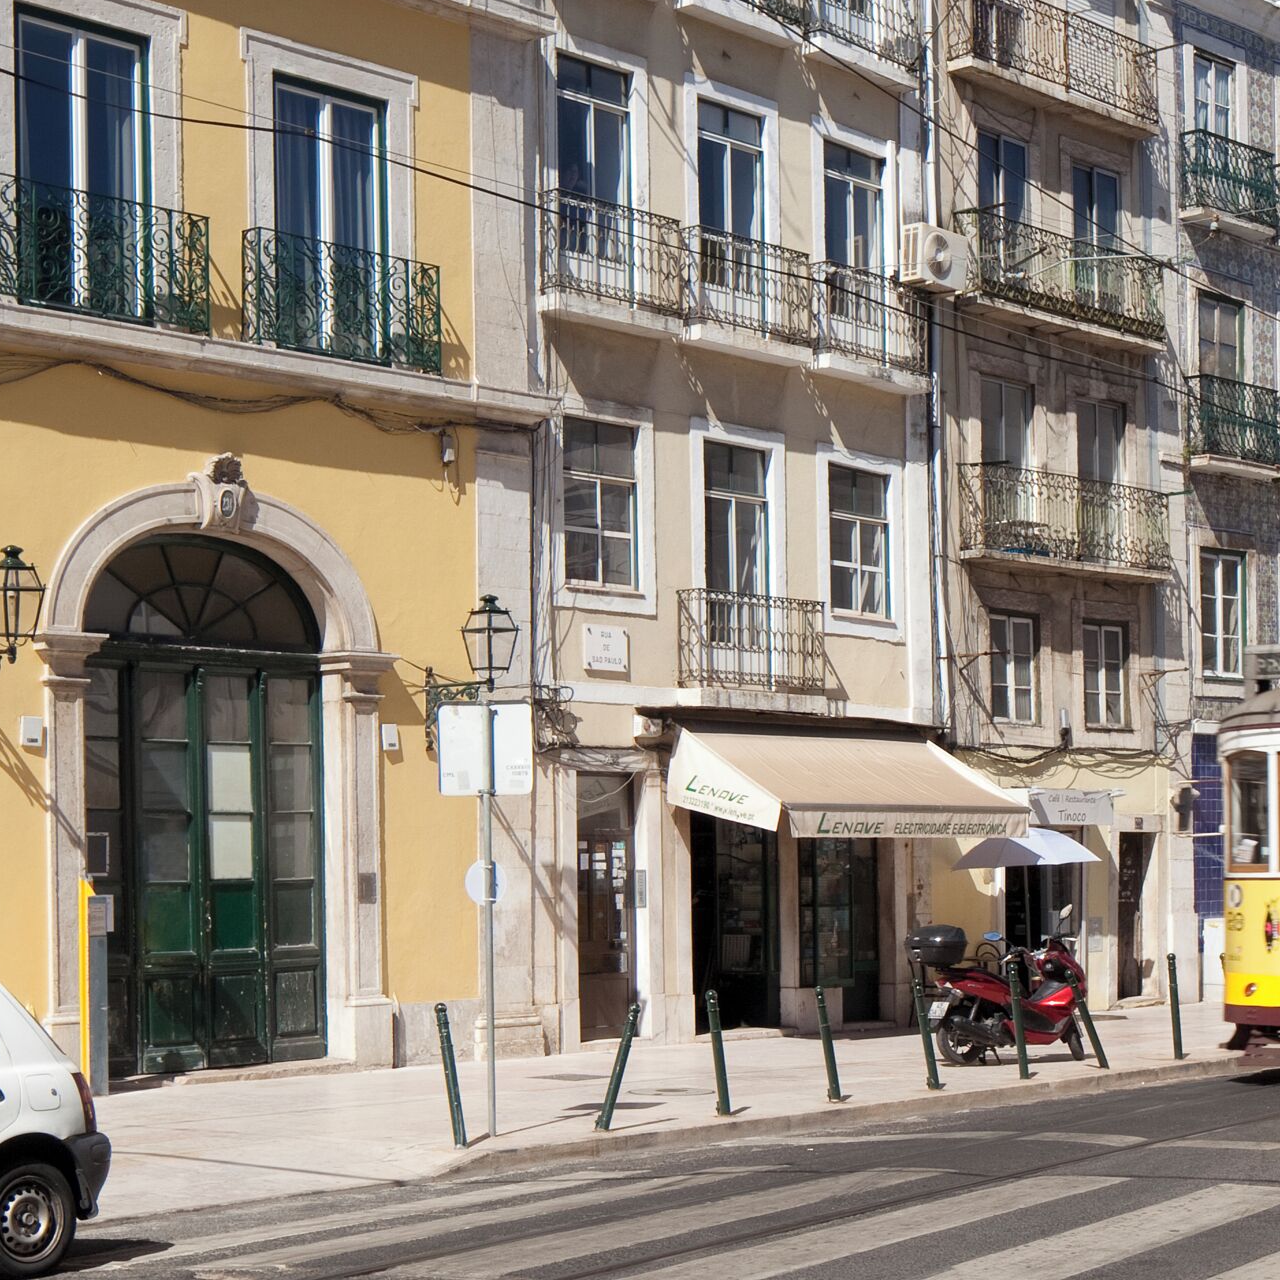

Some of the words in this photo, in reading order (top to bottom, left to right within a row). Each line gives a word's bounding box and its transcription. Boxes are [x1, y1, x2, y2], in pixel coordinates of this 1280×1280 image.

[604, 656, 622, 665] PAULO
[1058, 809, 1087, 822] Tinoco
[817, 812, 884, 835] LENAVE
[894, 822, 951, 835] ELECTRICIDADE
